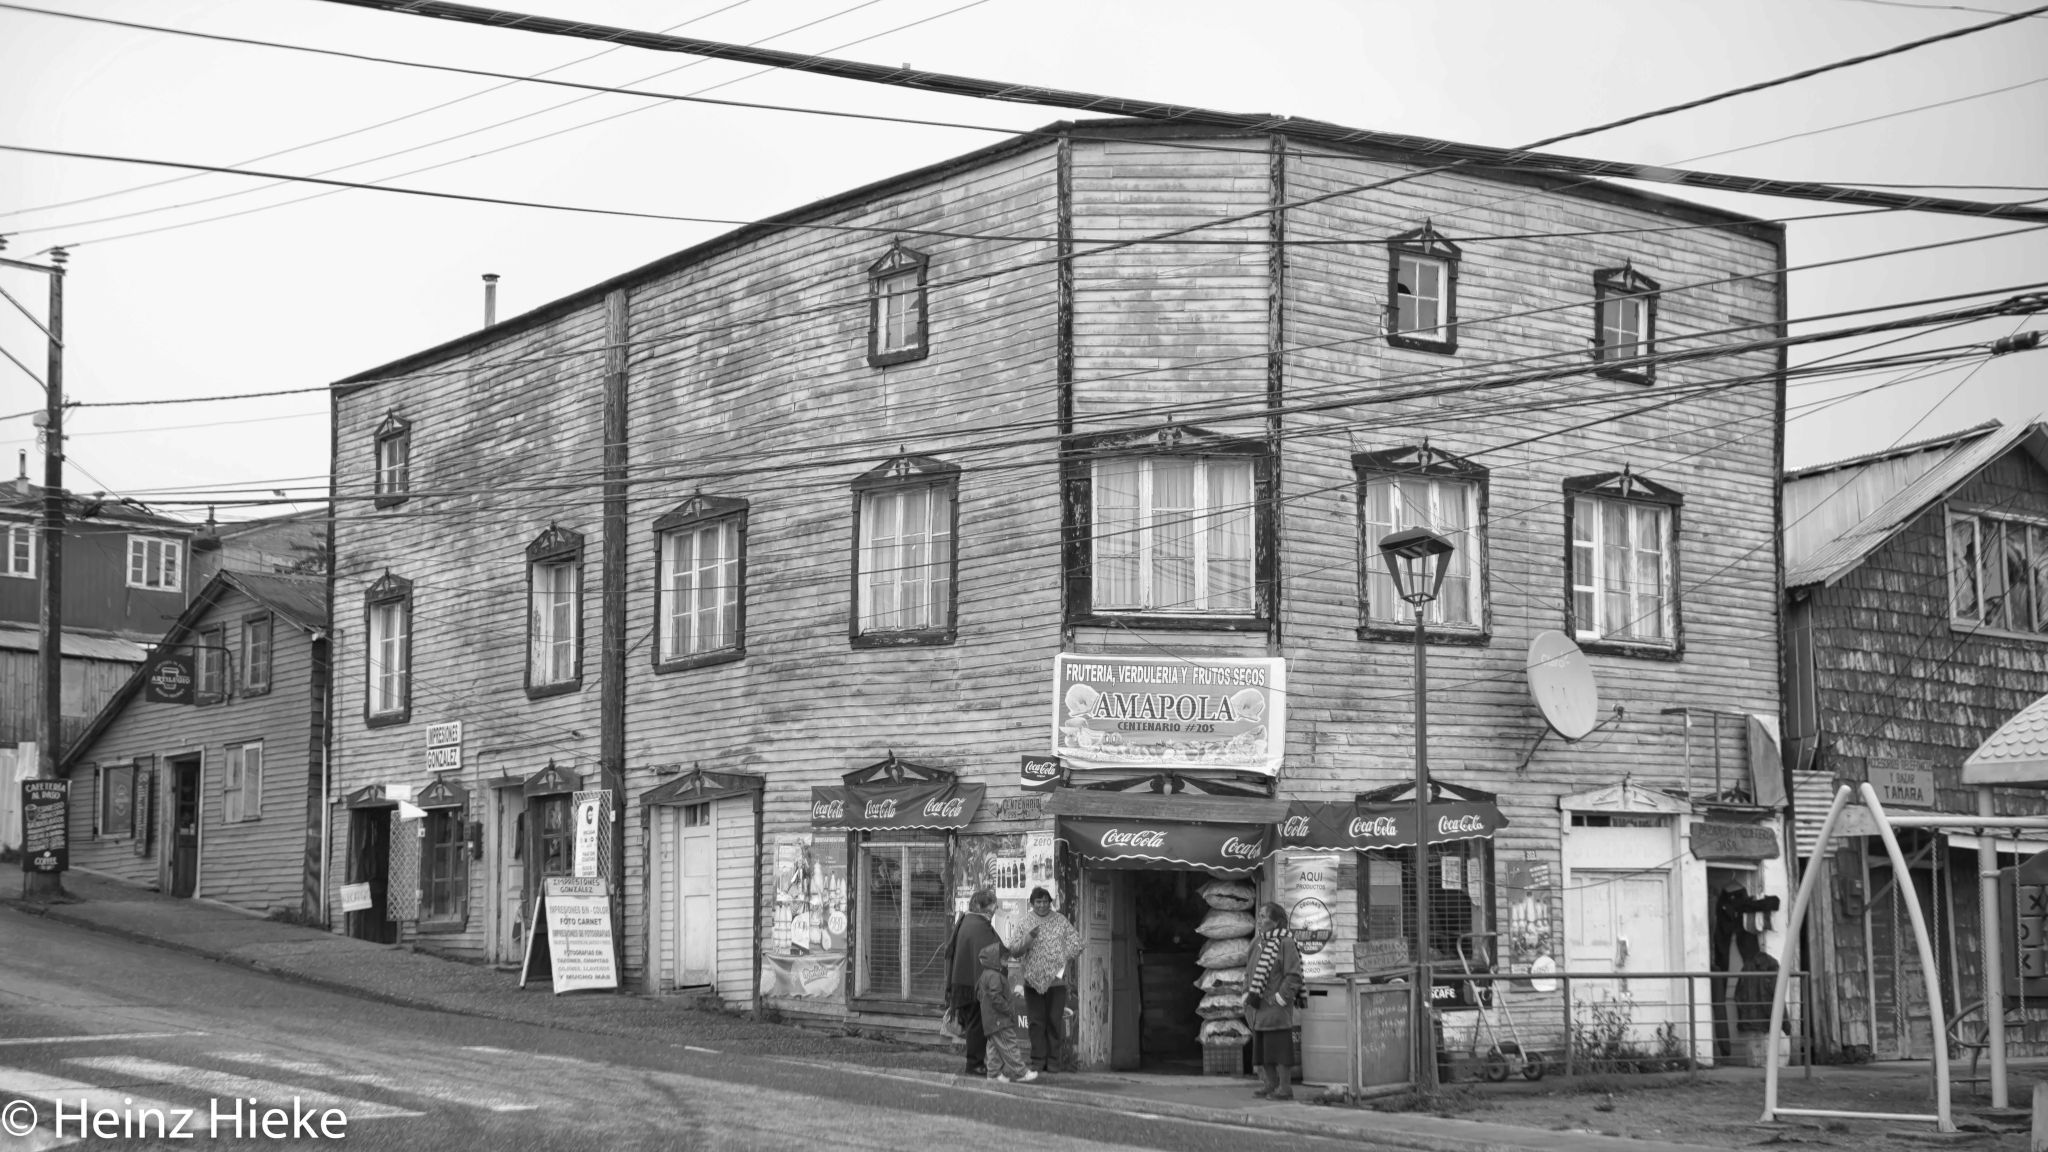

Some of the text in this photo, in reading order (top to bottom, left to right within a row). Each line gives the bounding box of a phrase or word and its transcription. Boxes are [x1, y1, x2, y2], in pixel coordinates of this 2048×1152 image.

[1066, 664, 1265, 687] FRUTERIA, VERDULERIA Y FRUTOS SECOS
[1094, 692, 1236, 722] AMAPOLA
[1117, 721, 1215, 733] CENTENARIO #205
[428, 748, 457, 768] GONZALEZ
[1025, 761, 1057, 775] Coca-Cola
[1883, 785, 1924, 800] TAMARA
[812, 799, 845, 819] Coca-Cola
[864, 798, 898, 819] Coca-Cola
[924, 797, 966, 817] Coca-Cola
[1349, 816, 1398, 838] Coca-Cola
[1438, 814, 1485, 835] Coca-Cola
[1034, 838, 1052, 847] zero
[1100, 828, 1168, 848] Coca-Cola
[1299, 871, 1323, 882] AQUI
